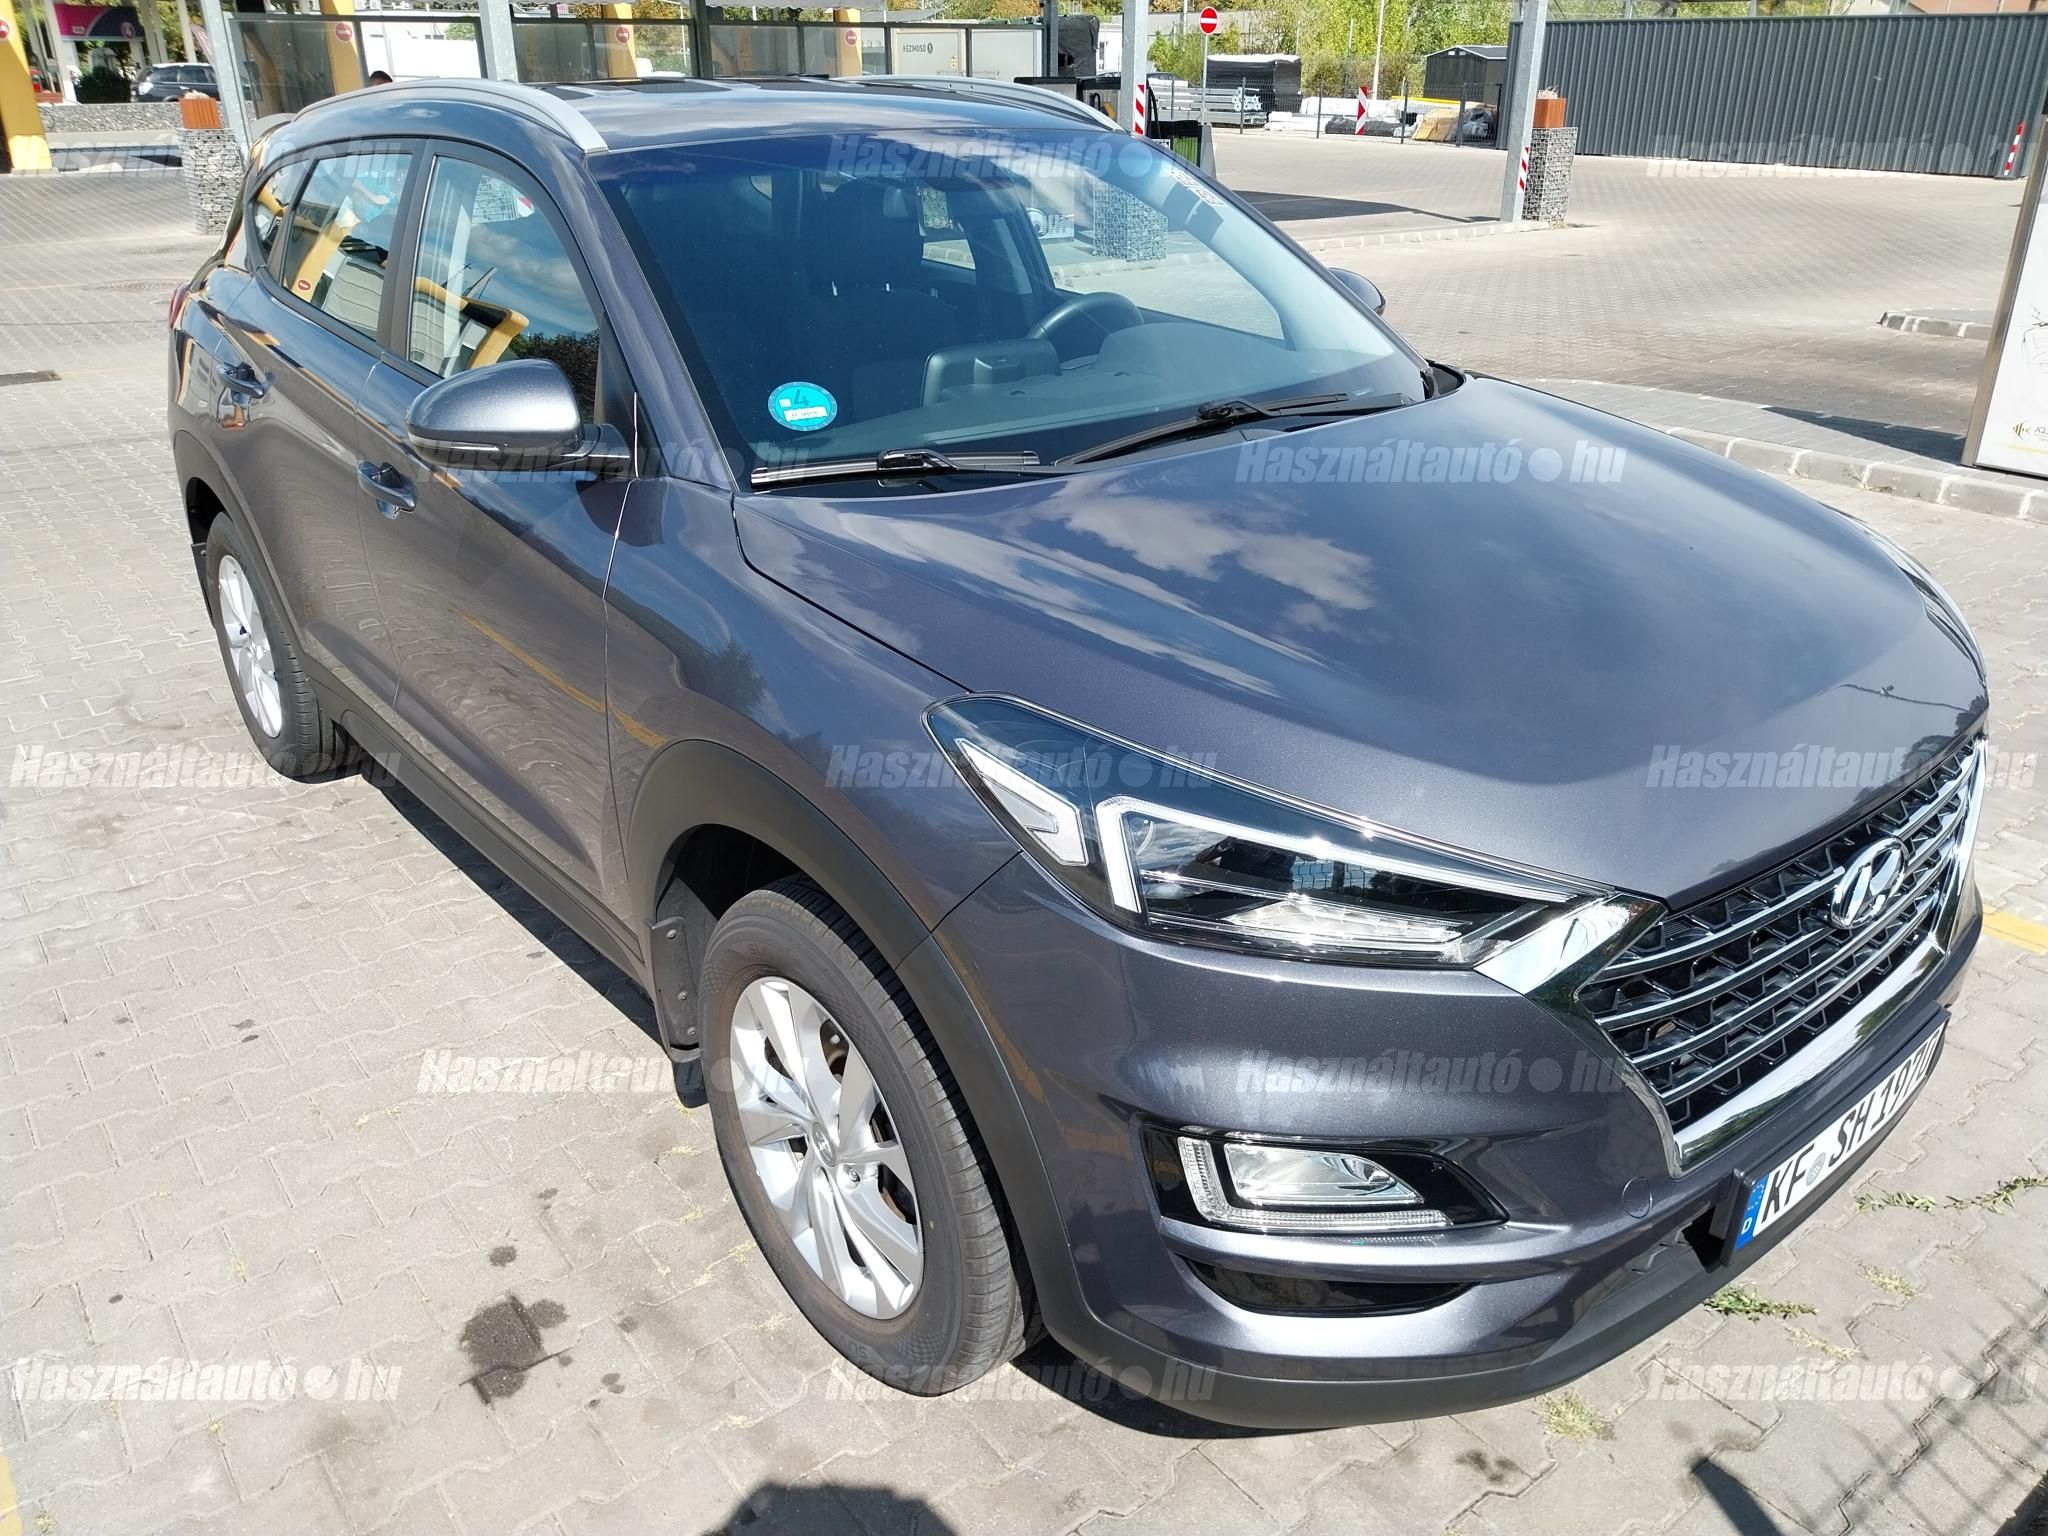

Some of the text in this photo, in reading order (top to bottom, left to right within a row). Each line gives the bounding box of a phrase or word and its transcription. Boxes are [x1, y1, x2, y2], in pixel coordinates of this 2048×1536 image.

[1761, 1144, 1815, 1224] KF
[1828, 1092, 1876, 1168] SH
[1741, 1218, 1753, 1235] D
